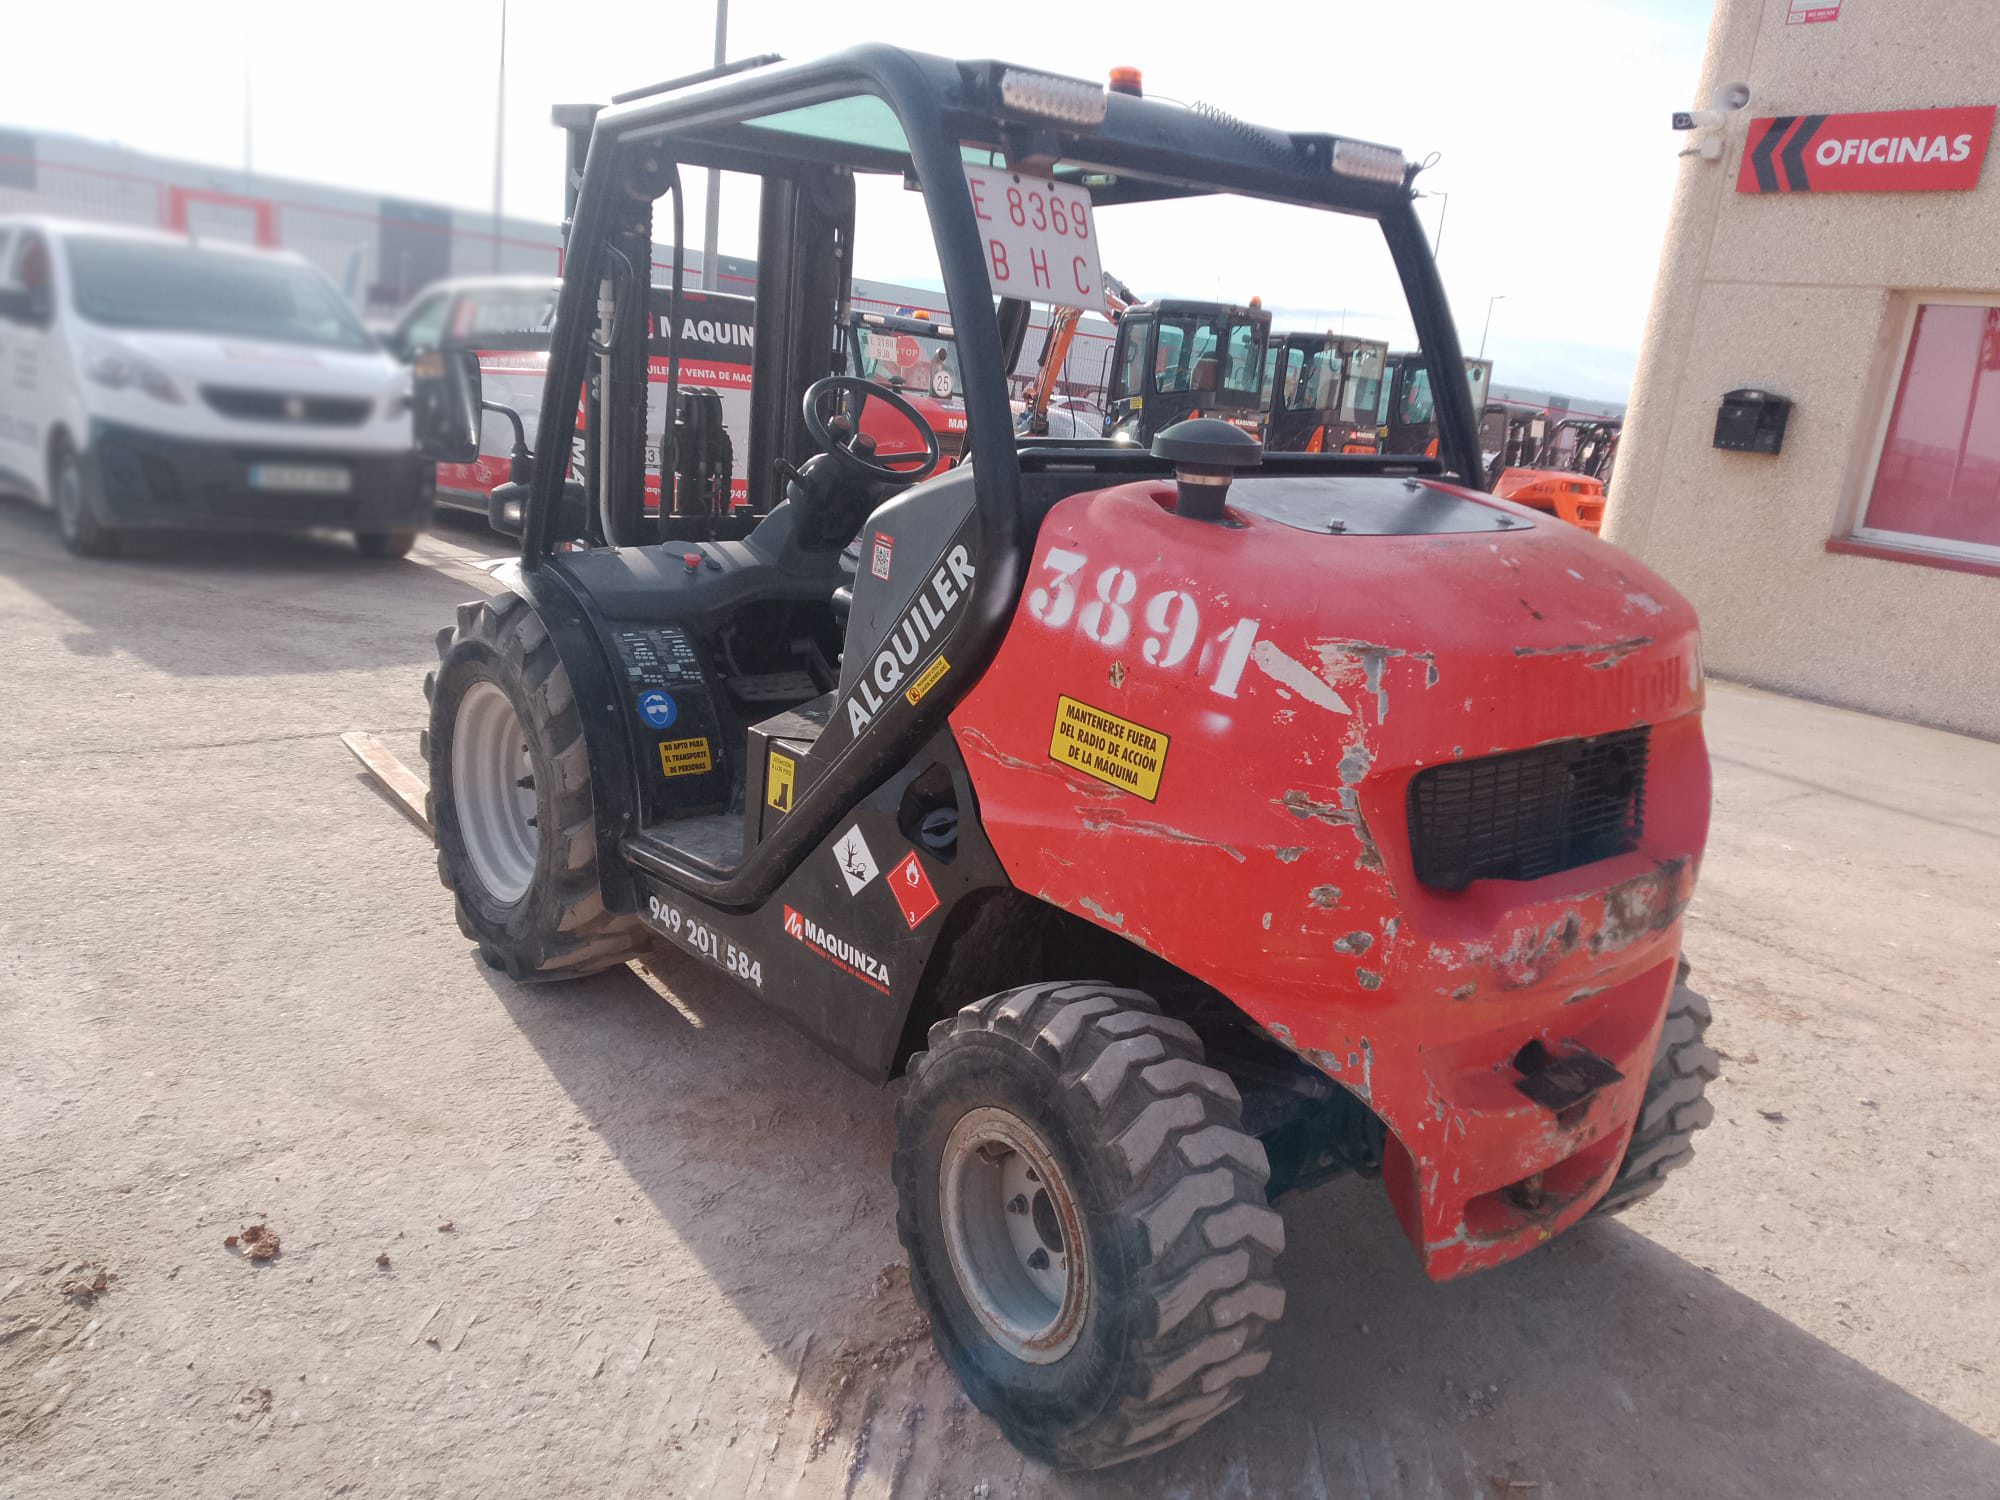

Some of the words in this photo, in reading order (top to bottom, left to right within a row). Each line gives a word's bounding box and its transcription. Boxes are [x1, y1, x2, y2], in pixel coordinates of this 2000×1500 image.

[1816, 134, 1973, 166] OFICINAS
[969, 178, 992, 220] E
[1007, 187, 1089, 239] 8369
[685, 367, 716, 380] VENTA
[718, 371, 730, 381] DE
[936, 375, 950, 392] 25
[729, 489, 747, 499] 949
[847, 544, 976, 738] ALQUILER
[1028, 547, 1260, 699] 3891
[674, 742, 689, 751] APTO
[689, 740, 704, 749] PARA
[1066, 704, 1126, 740] MANTENERSE
[1127, 728, 1157, 752] FUERA
[665, 755, 672, 763] EL
[672, 750, 706, 763] TRANSPORTE
[1060, 721, 1075, 739] DEL
[1077, 728, 1106, 751] RADIO
[1107, 740, 1121, 757] DE
[1121, 747, 1157, 772] ACCIÓN
[670, 766, 677, 774] DE
[678, 762, 706, 773] PERSONAS
[1068, 745, 1080, 760] DE
[1081, 750, 1092, 766] LA
[1094, 755, 1138, 786] MÁQUINA
[909, 911, 915, 922] 3
[649, 895, 681, 934] 949
[686, 919, 718, 961] 201
[726, 943, 762, 988] 584
[805, 918, 890, 986] MAQUINZA
